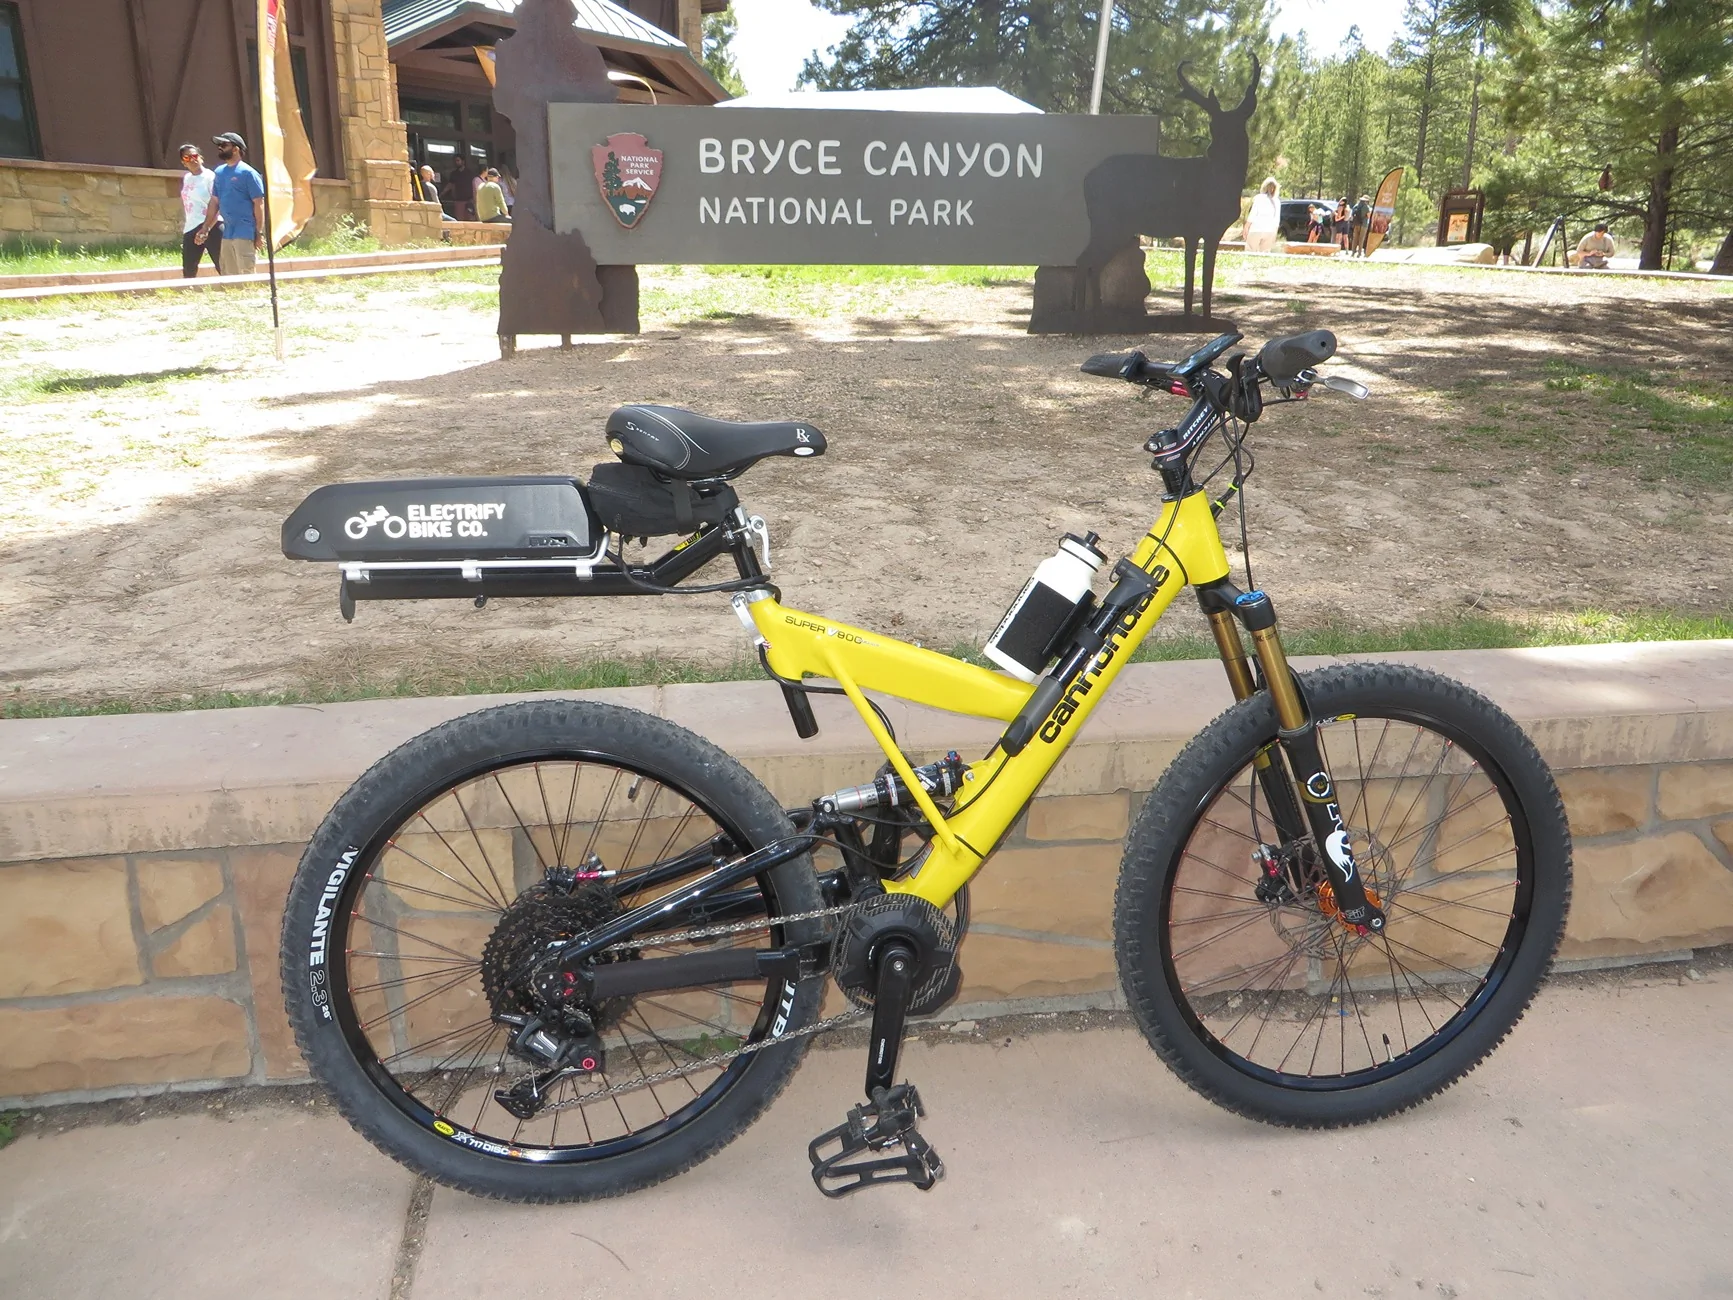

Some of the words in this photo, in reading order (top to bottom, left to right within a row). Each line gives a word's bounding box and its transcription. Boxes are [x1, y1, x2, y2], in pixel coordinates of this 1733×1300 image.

[620, 155, 659, 163] NATIONAL
[625, 168, 654, 176] SERVICE
[699, 137, 842, 175] BRYCE
[863, 140, 1043, 178] CANYON
[699, 196, 873, 225] NATIONAL
[889, 198, 974, 226] PARK
[1182, 406, 1208, 440] RITCHEY
[407, 503, 506, 521] ELECTRIFY
[408, 521, 453, 539] BIKE
[457, 520, 489, 538] CO.
[784, 615, 826, 634] SUPER
[1039, 564, 1170, 744] cannondae
[310, 850, 359, 967] VIGILANTE
[310, 969, 329, 1007] 2.3
